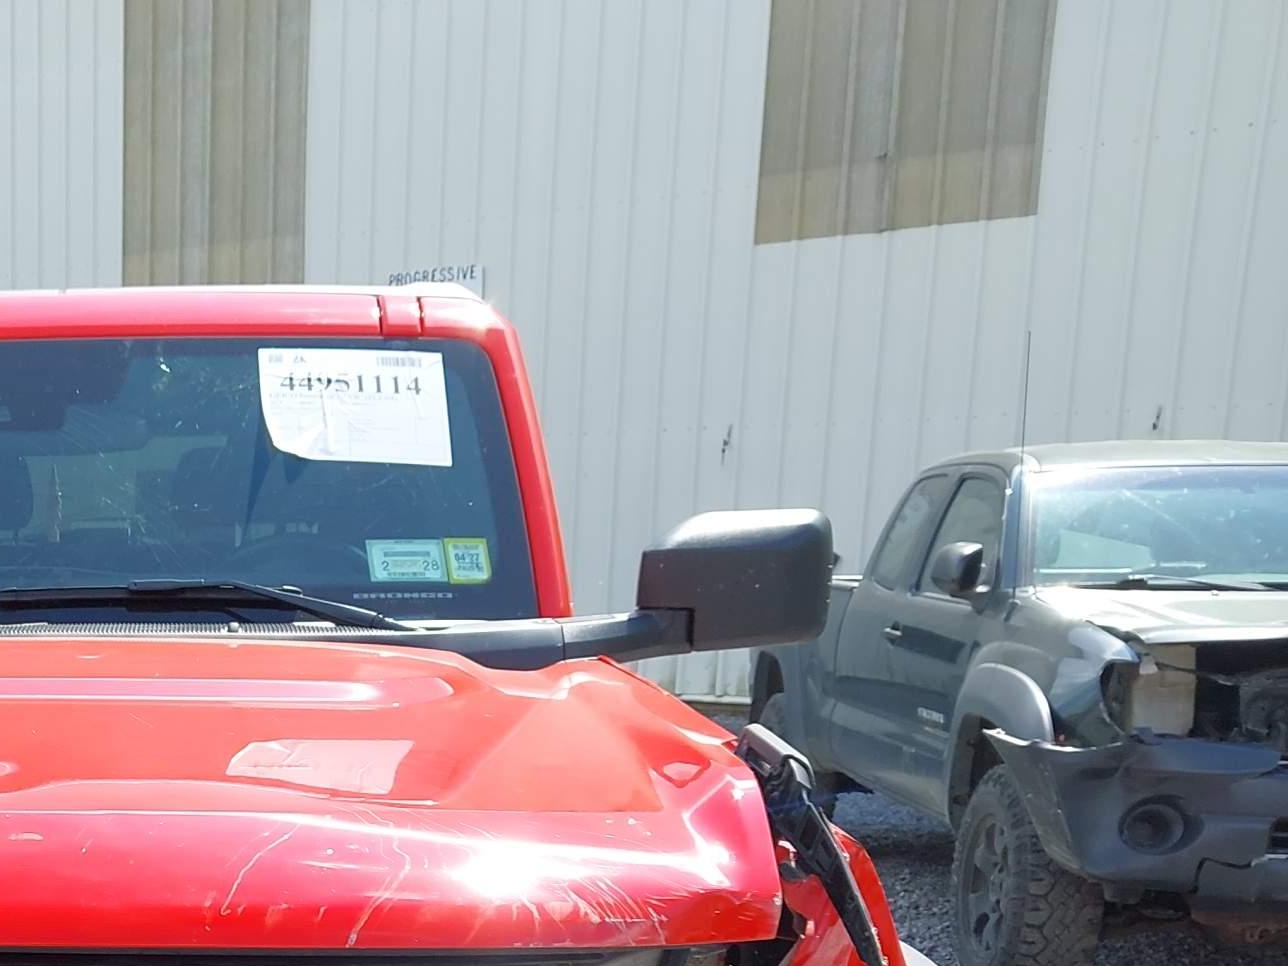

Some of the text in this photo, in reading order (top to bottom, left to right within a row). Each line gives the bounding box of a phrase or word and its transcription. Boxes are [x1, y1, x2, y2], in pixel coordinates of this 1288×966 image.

[388, 264, 477, 287] PROGRESSIVE
[280, 372, 423, 394] 44951114
[422, 560, 440, 571] 28
